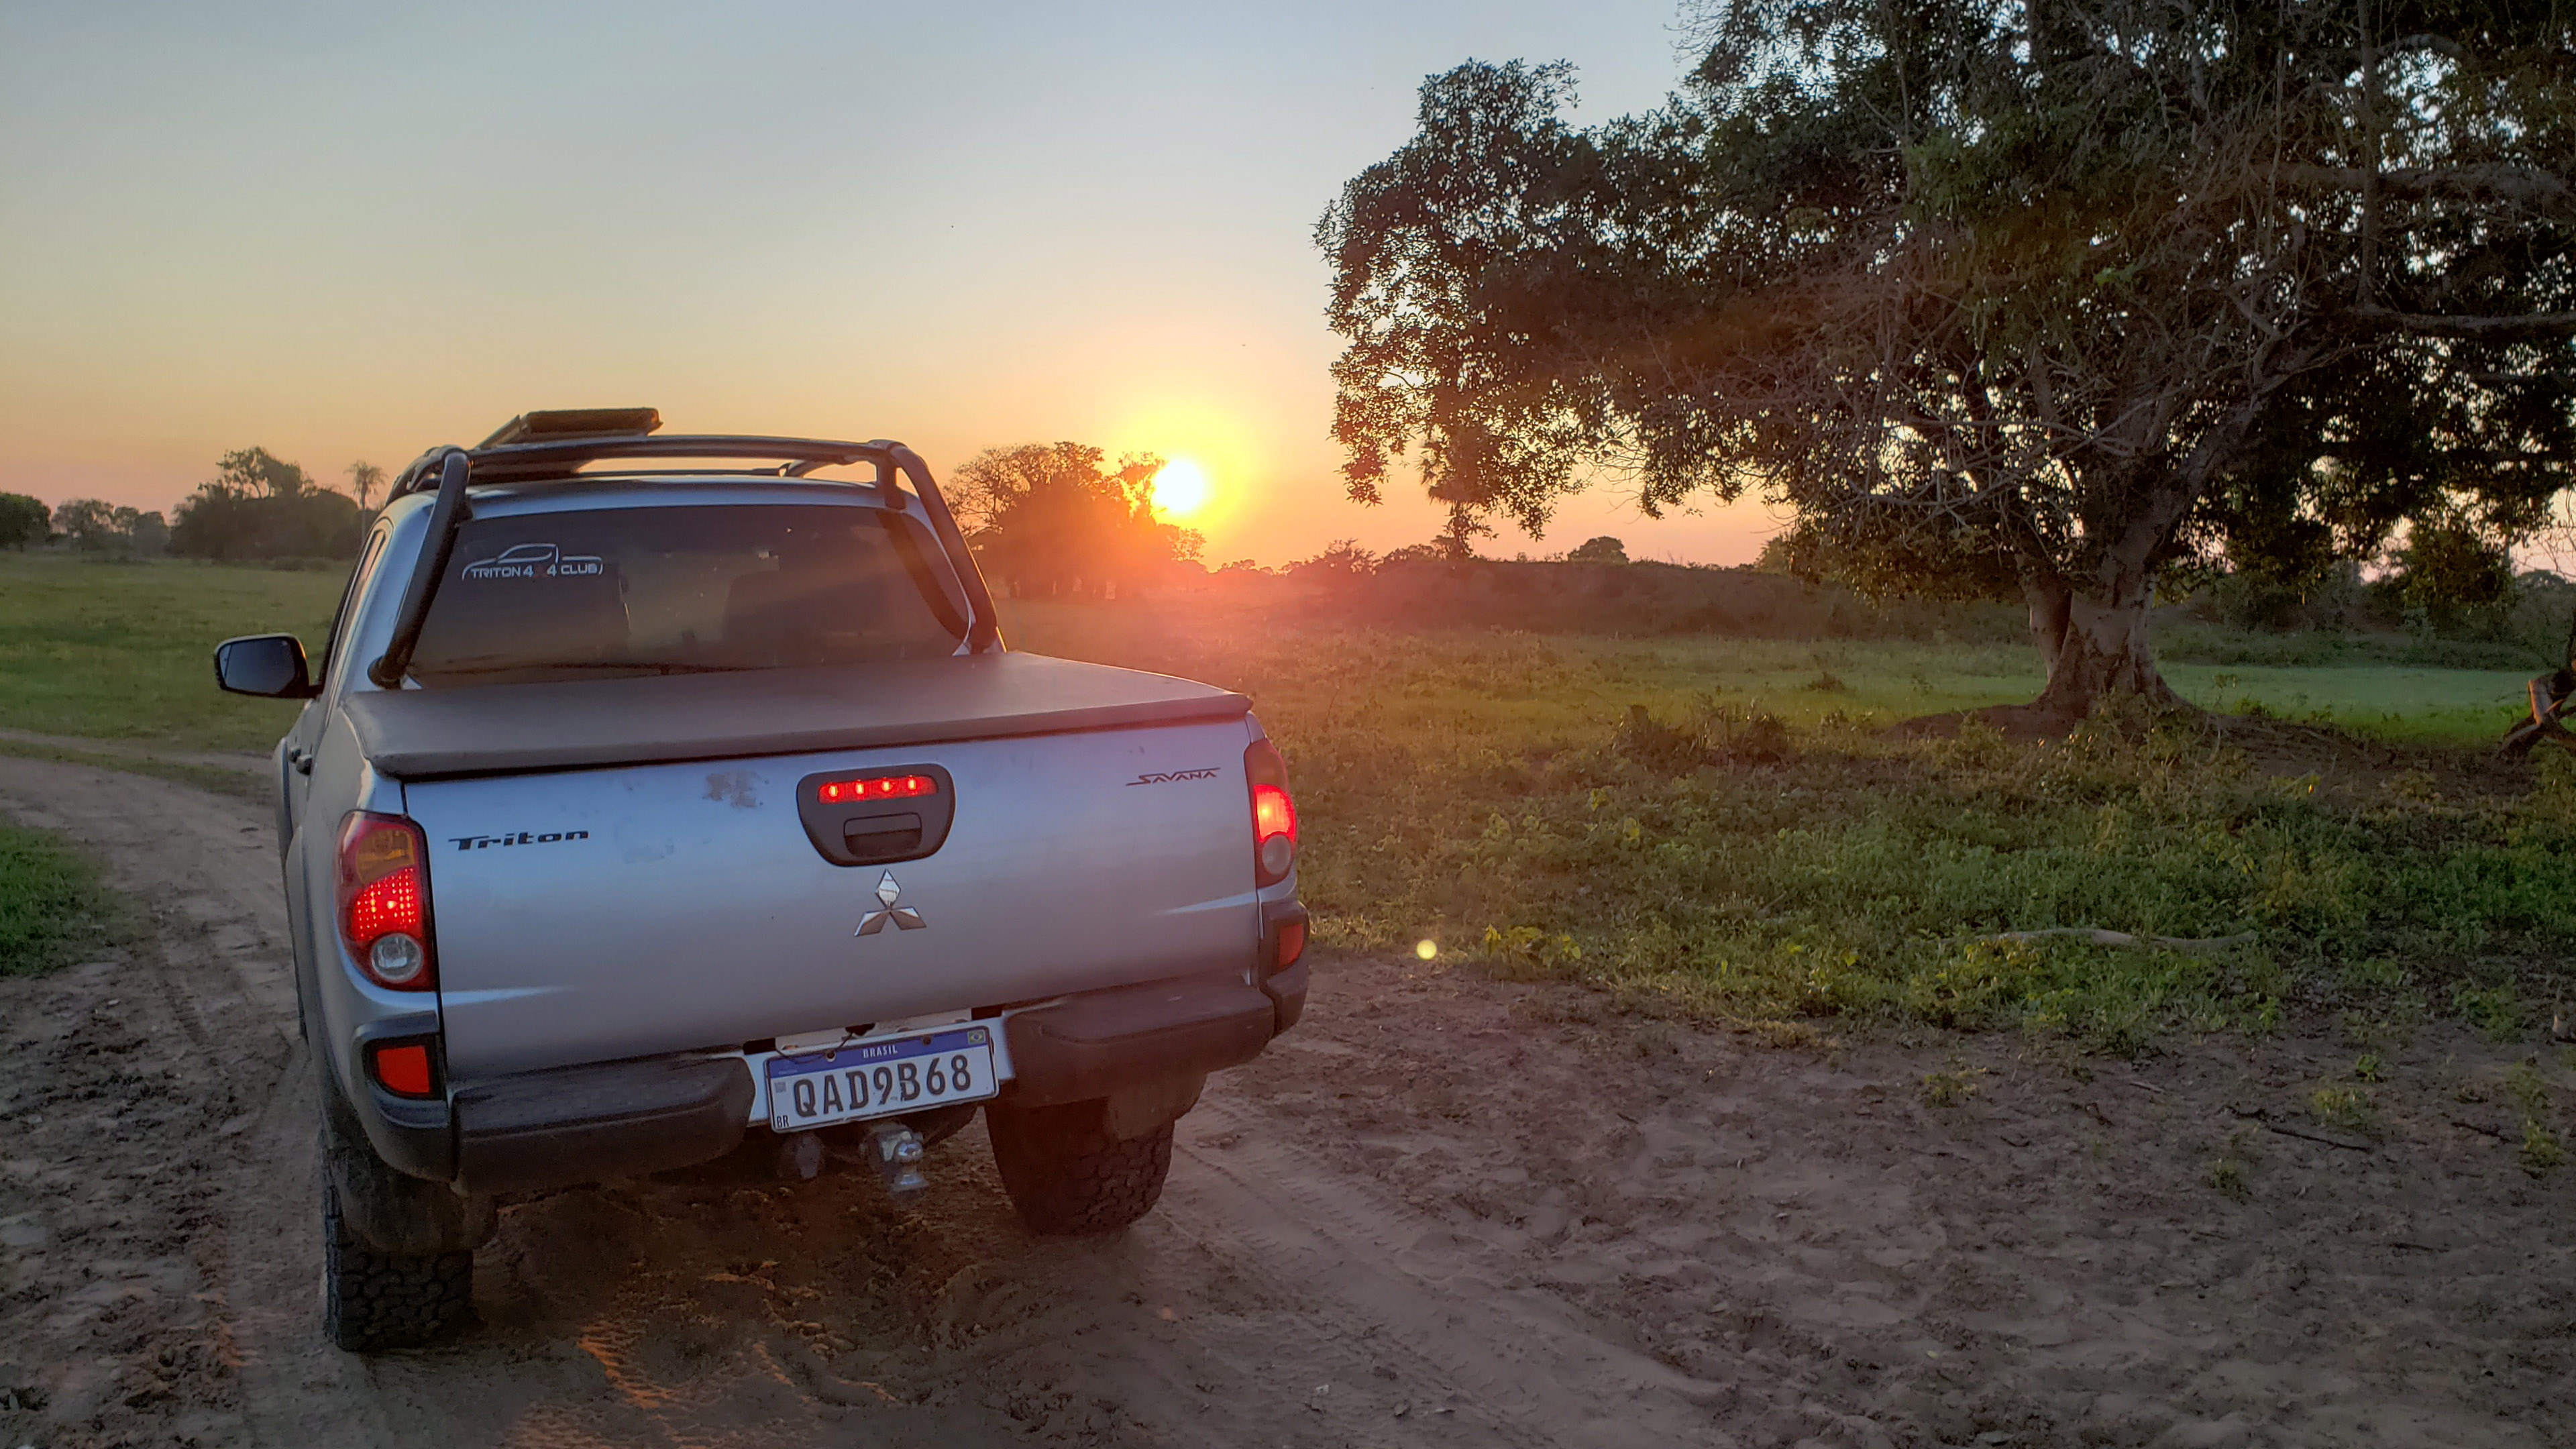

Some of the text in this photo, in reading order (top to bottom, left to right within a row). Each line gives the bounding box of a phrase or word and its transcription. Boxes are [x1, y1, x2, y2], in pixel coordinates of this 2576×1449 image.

[471, 566, 521, 580] TRITON
[560, 563, 598, 576] CLUB
[1125, 767, 1221, 786] SAVANA
[448, 830, 589, 851] Triton
[863, 1044, 898, 1059] BRASIL
[794, 1055, 971, 1118] QAD9B68
[776, 1115, 789, 1128] BR
